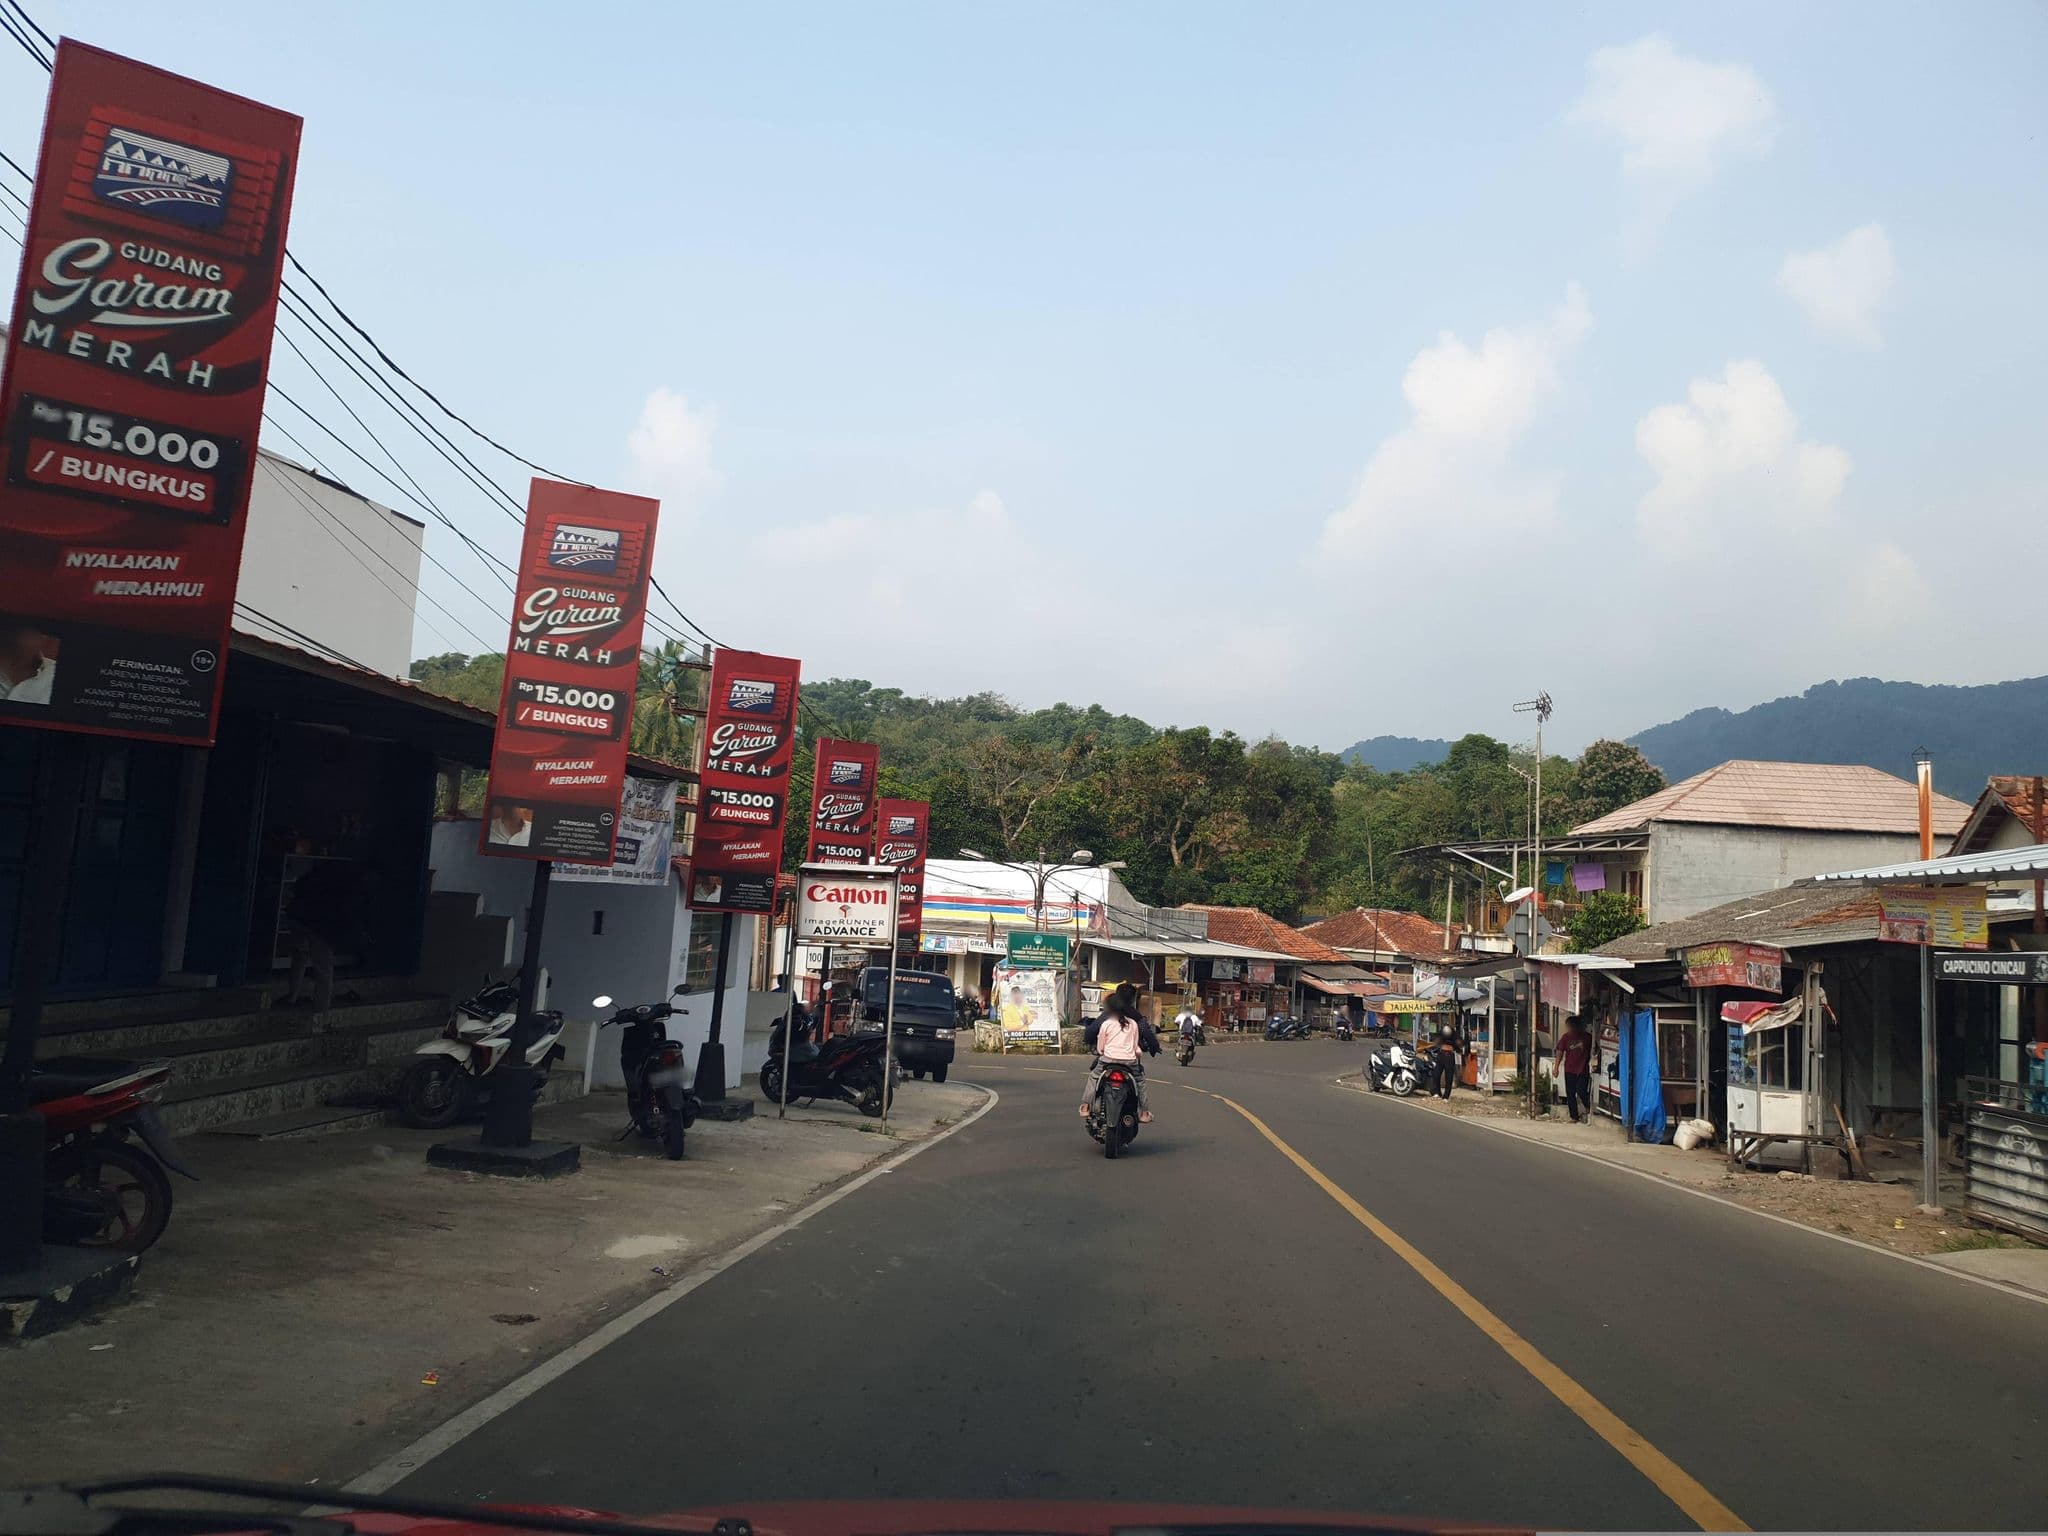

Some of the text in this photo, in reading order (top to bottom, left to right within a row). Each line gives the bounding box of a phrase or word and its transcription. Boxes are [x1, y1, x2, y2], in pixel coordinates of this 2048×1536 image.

[120, 242, 222, 281] GUDANG
[32, 237, 233, 325] Garam
[22, 319, 215, 388] MERAH
[65, 411, 220, 470] 15.000
[60, 456, 207, 502] BUNGKUS
[65, 552, 180, 571] NYALAKAN
[94, 579, 205, 598] MERAHMU!
[562, 586, 616, 604] GUDANG
[518, 587, 622, 635] Garam
[514, 636, 611, 664] MERAH
[111, 658, 184, 675] PERINGATAN:
[110, 679, 181, 695] SAYA TERKENA
[518, 681, 615, 711] Rp 15.000
[532, 709, 608, 729] BUNGKUS
[737, 723, 773, 733] GUDANG
[709, 723, 777, 757] Garam
[535, 761, 594, 771] NYALAKAN
[706, 758, 771, 776] MERAH
[549, 775, 607, 785] MERAHMU!
[721, 791, 774, 808] 15.000
[835, 793, 861, 801] GUDANG
[720, 809, 770, 821] BUNGKUS
[816, 794, 864, 820] Garam
[815, 820, 860, 834] MERAH
[722, 842, 761, 851] NYALAKAN
[825, 845, 862, 857] 15.000
[878, 843, 918, 864] Garam
[806, 884, 887, 905] Canon
[804, 917, 885, 927] imageRUNNER
[813, 926, 877, 937] ADVANCE
[808, 952, 822, 962] 100
[1943, 960, 2026, 976] CAPPUCINO CINCAU
